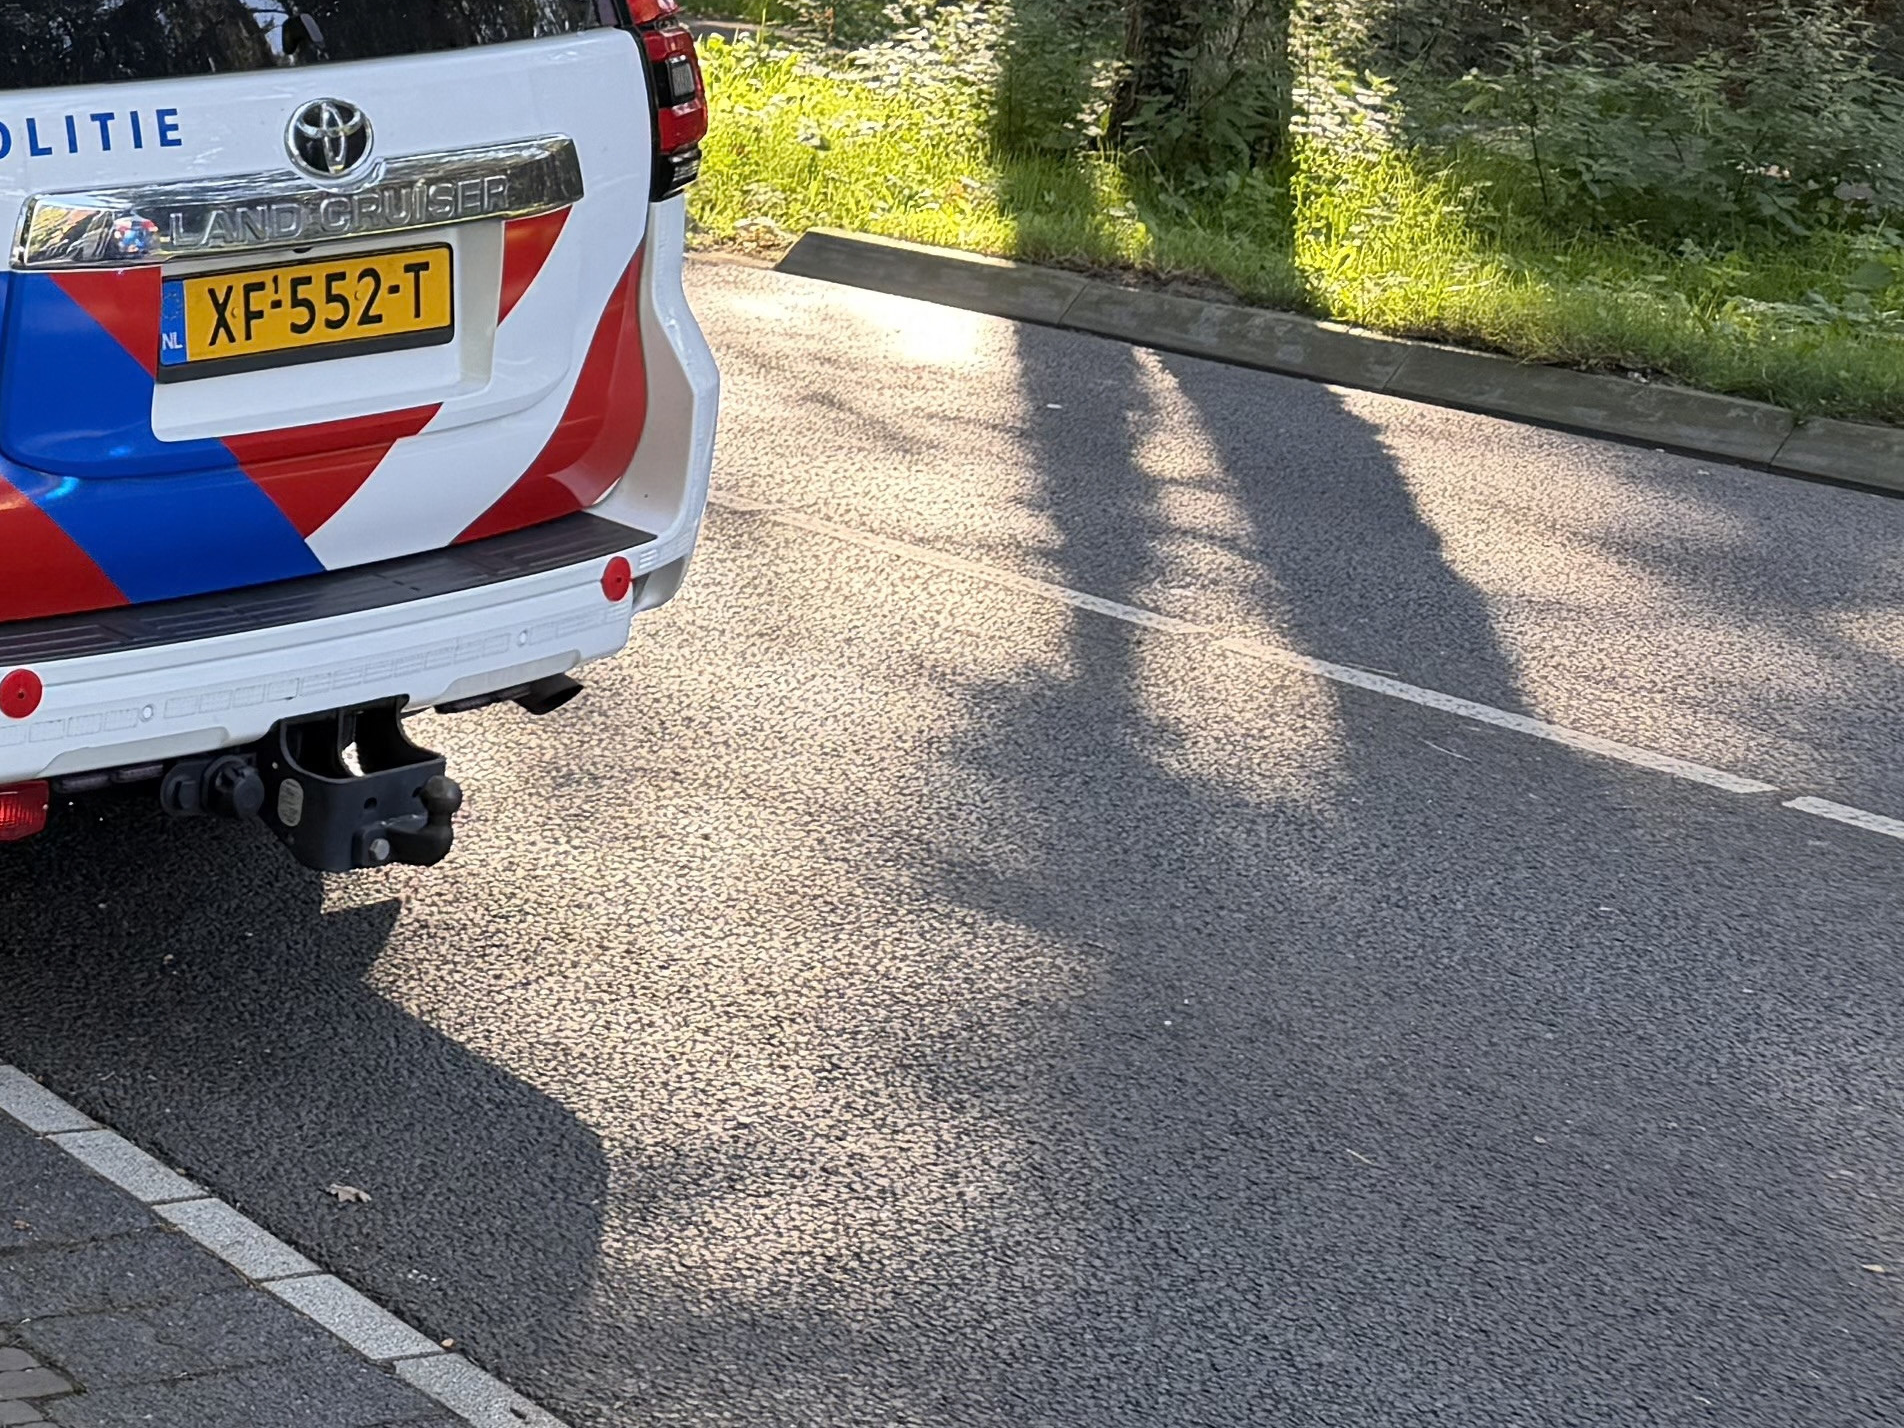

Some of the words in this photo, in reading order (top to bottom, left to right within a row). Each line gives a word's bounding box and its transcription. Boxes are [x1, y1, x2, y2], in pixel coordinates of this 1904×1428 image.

[169, 203, 303, 247] LAND
[319, 174, 509, 231] CRUISER
[162, 332, 183, 351] NL
